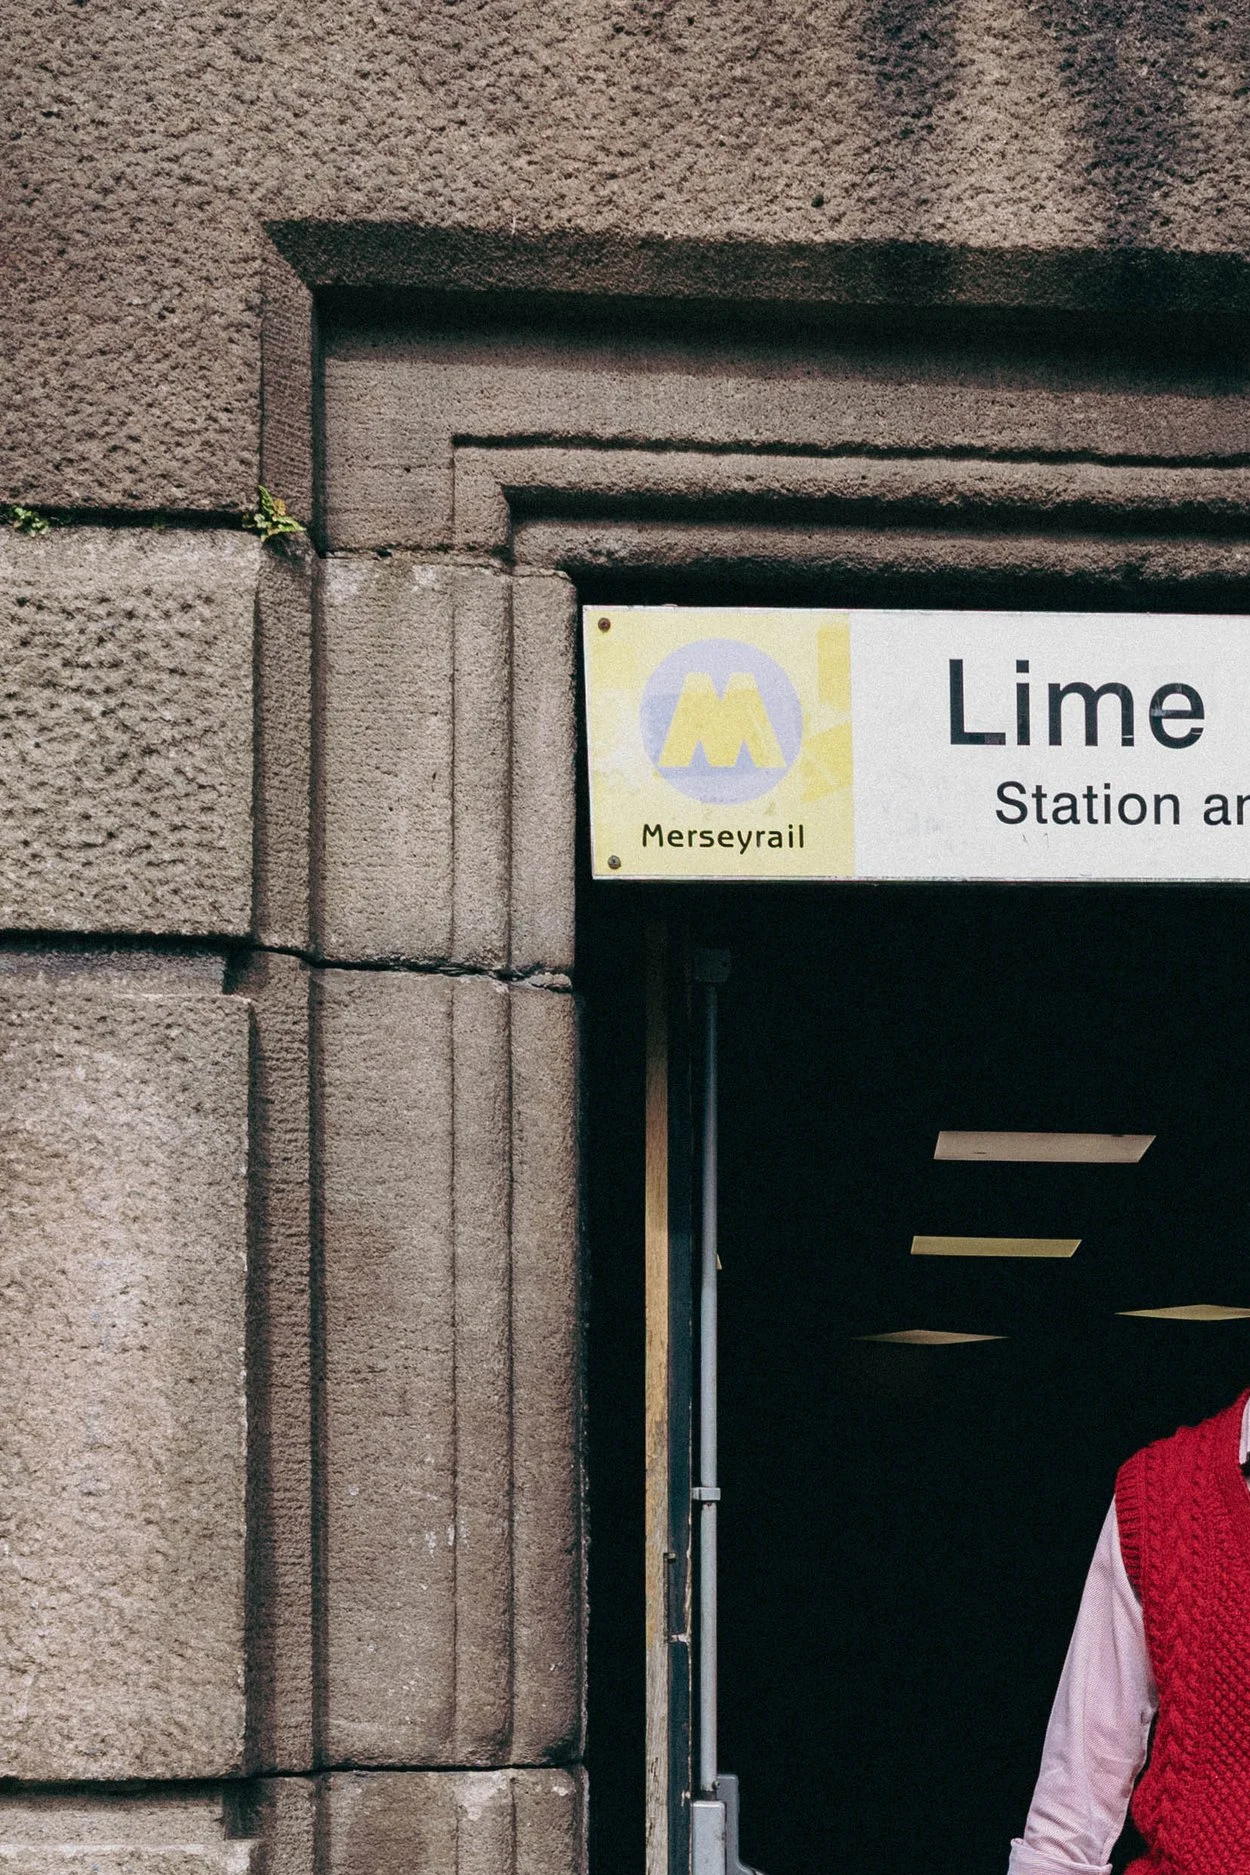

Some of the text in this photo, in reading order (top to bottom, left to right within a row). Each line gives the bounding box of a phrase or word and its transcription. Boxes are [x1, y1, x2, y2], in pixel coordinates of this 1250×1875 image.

[658, 671, 788, 769] M
[949, 658, 1205, 748] Lime
[995, 780, 1180, 826] Station
[642, 823, 804, 855] Merseyrail
